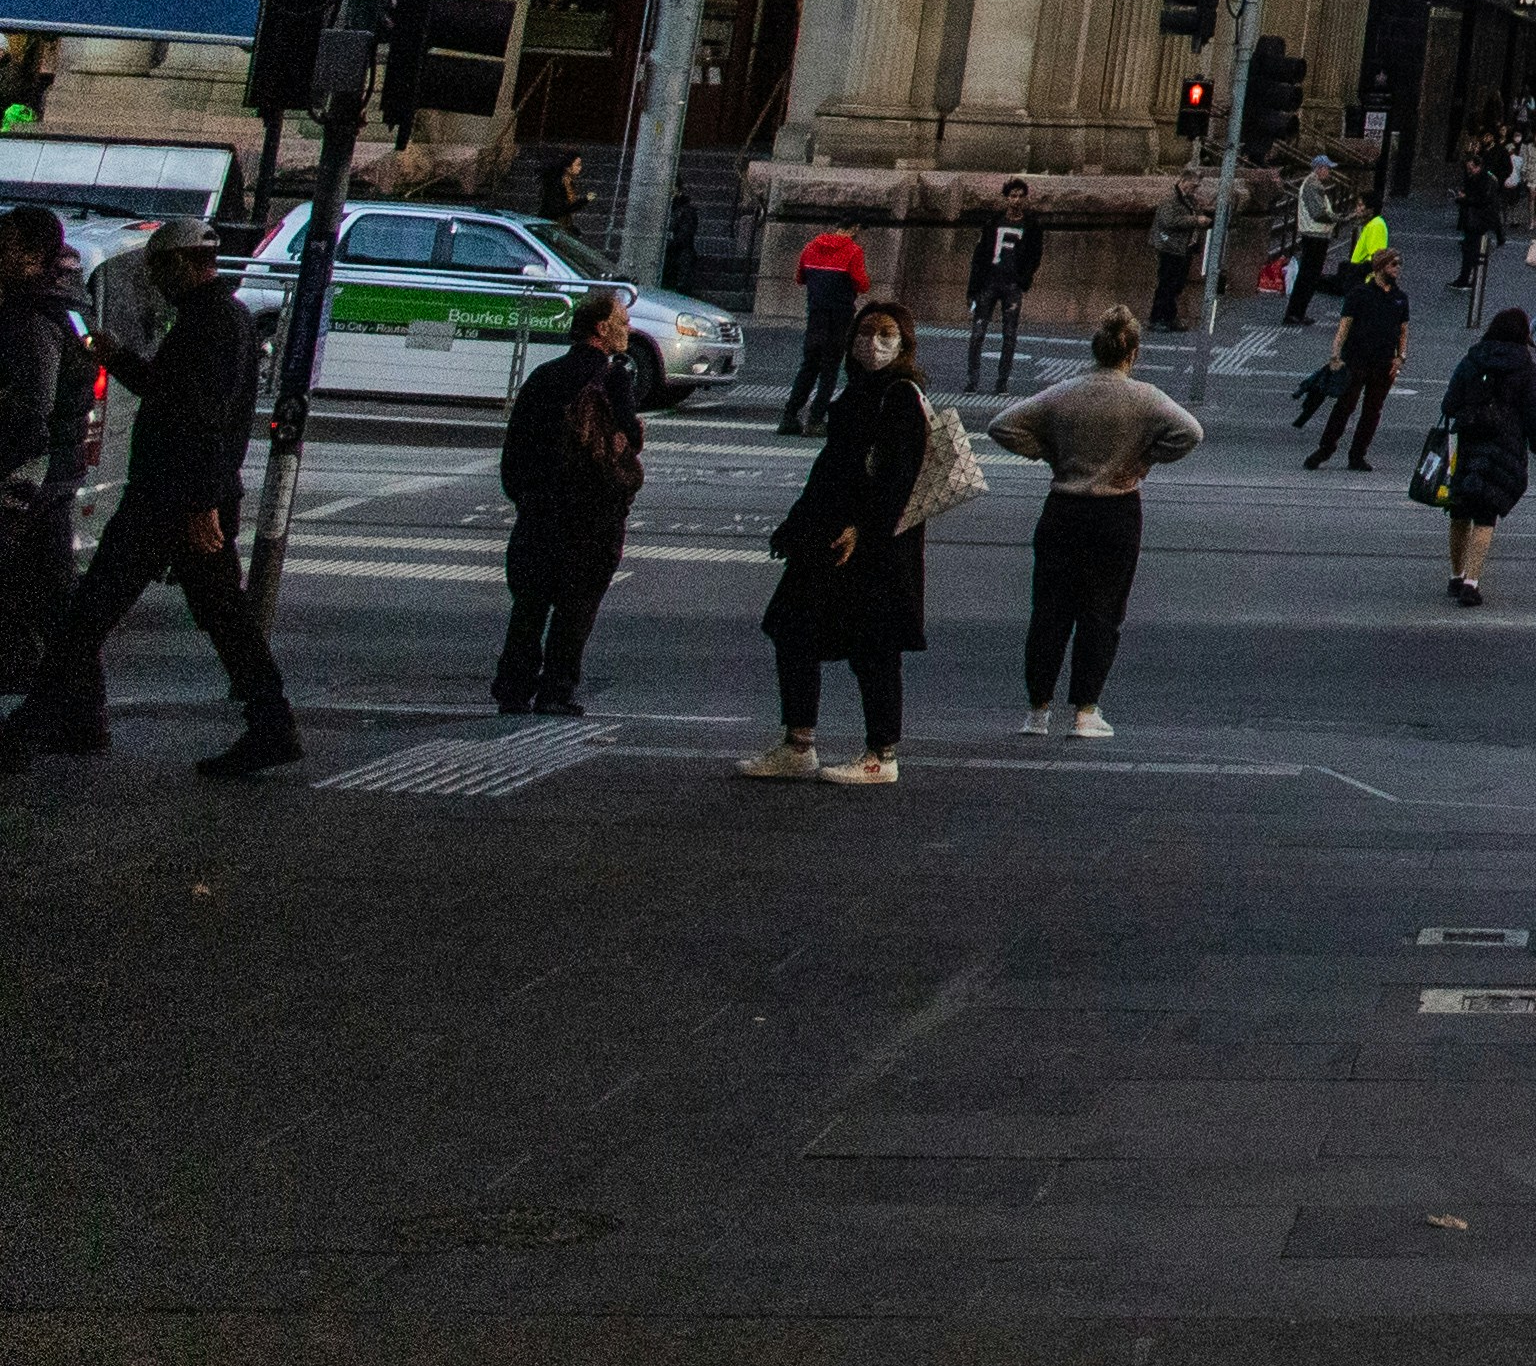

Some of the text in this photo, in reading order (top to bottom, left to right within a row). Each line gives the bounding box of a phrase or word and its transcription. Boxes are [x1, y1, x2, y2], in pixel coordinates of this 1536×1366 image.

[992, 226, 1024, 264] F
[449, 309, 504, 325] Bourke
[508, 311, 554, 329] Seet
